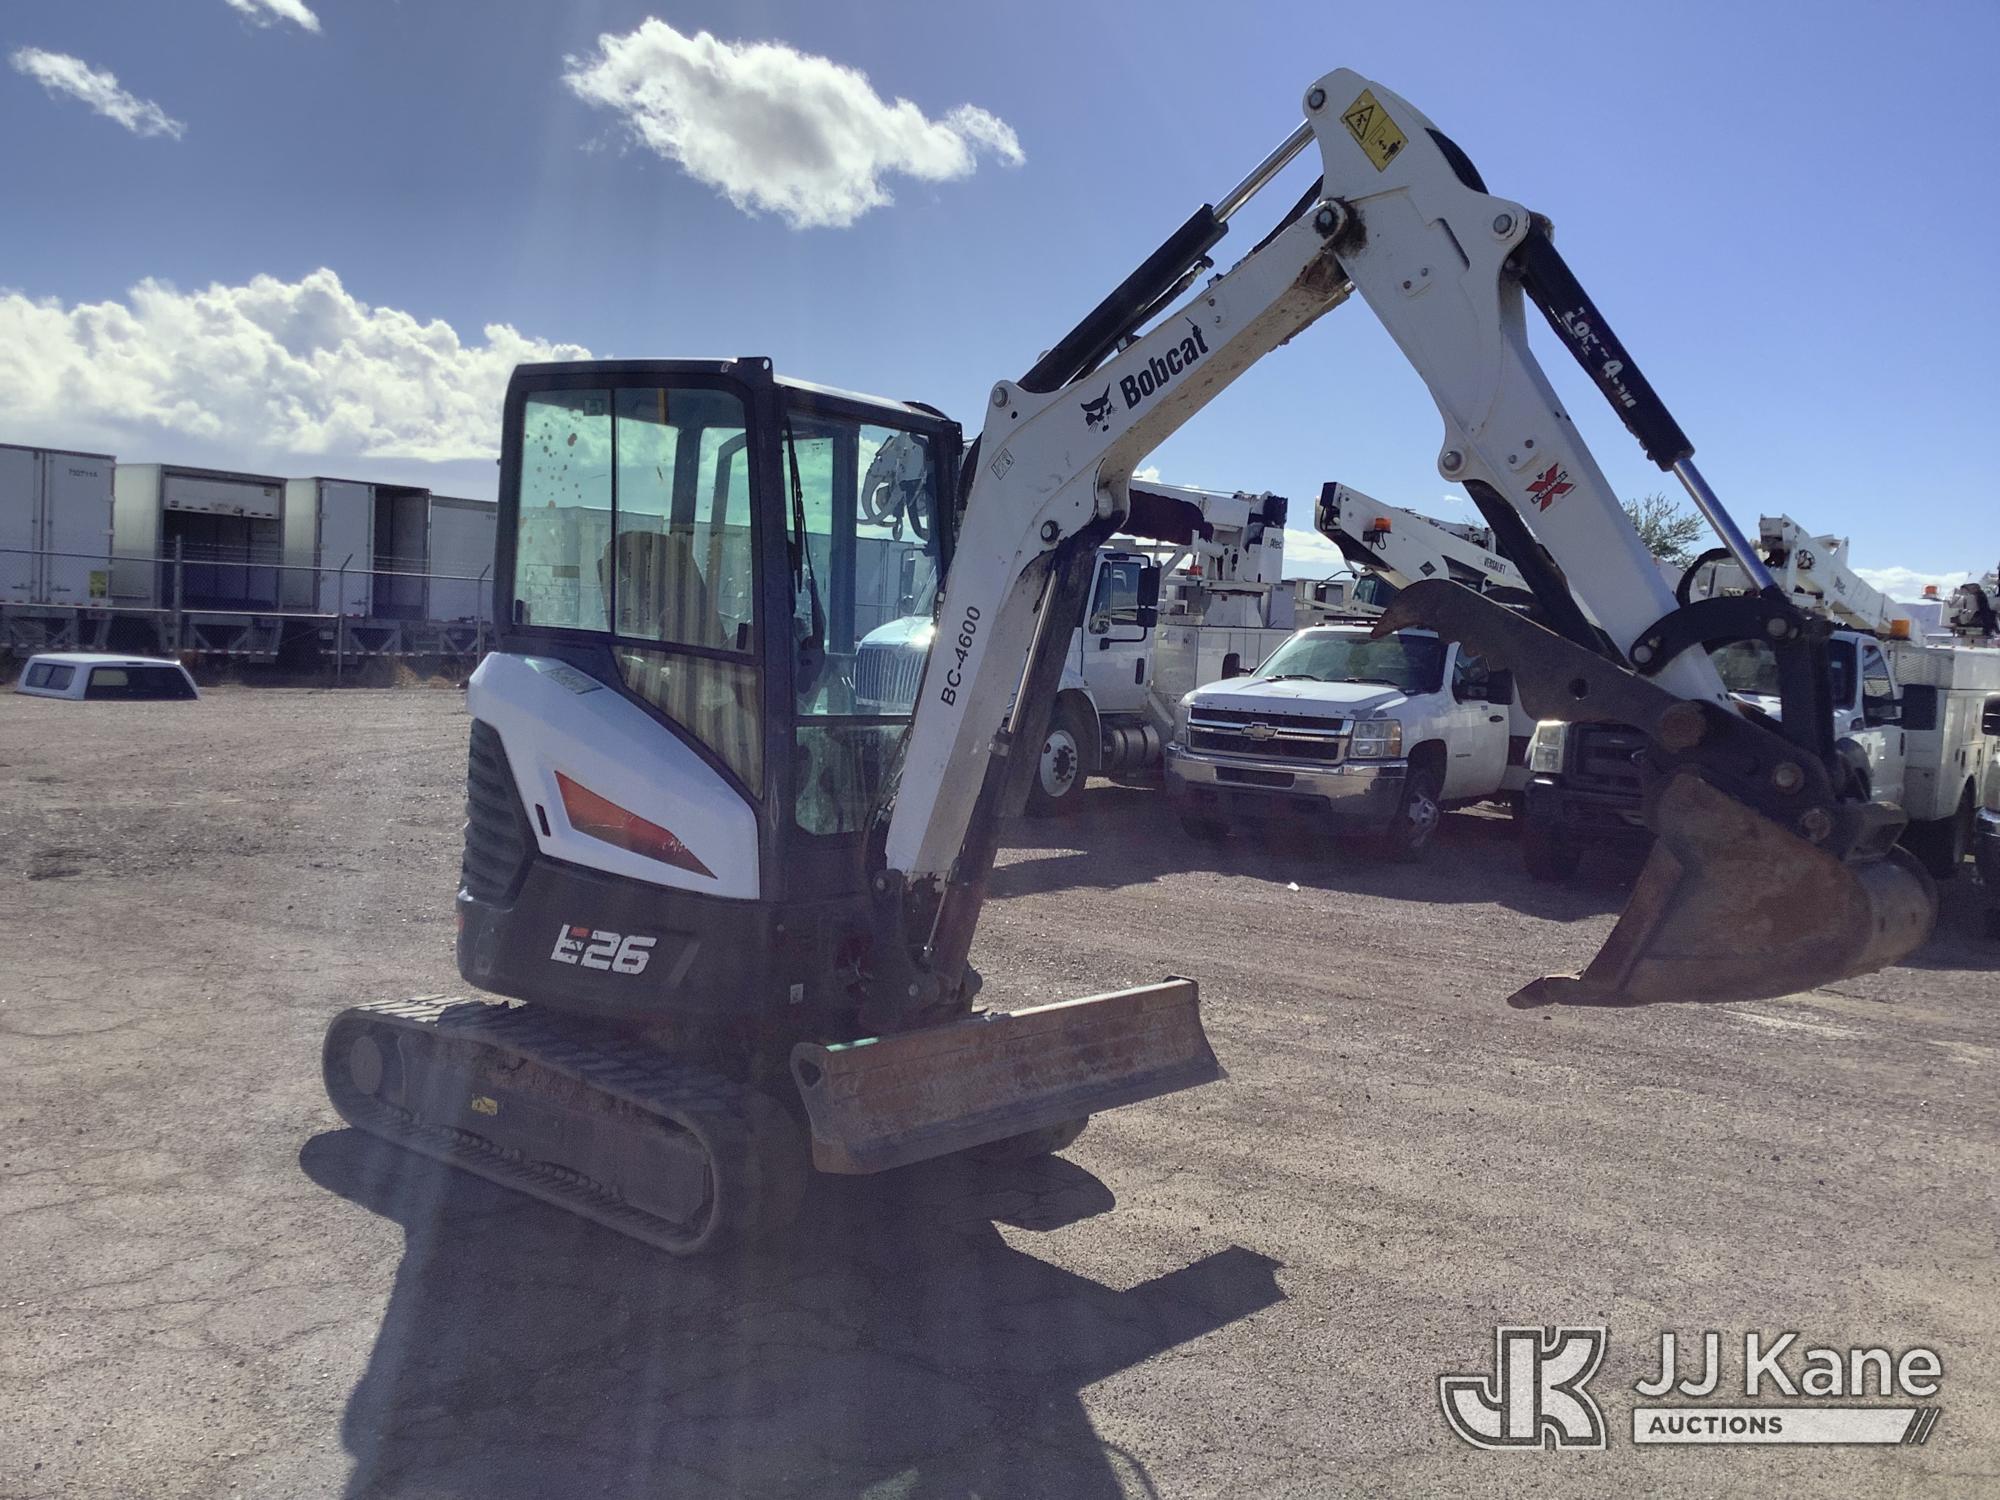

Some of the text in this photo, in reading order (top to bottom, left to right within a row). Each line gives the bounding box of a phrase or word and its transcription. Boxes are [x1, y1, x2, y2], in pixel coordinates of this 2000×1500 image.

[1119, 325, 1209, 410] Bobcat
[940, 606, 981, 706] BC-4600
[550, 924, 657, 975] E26
